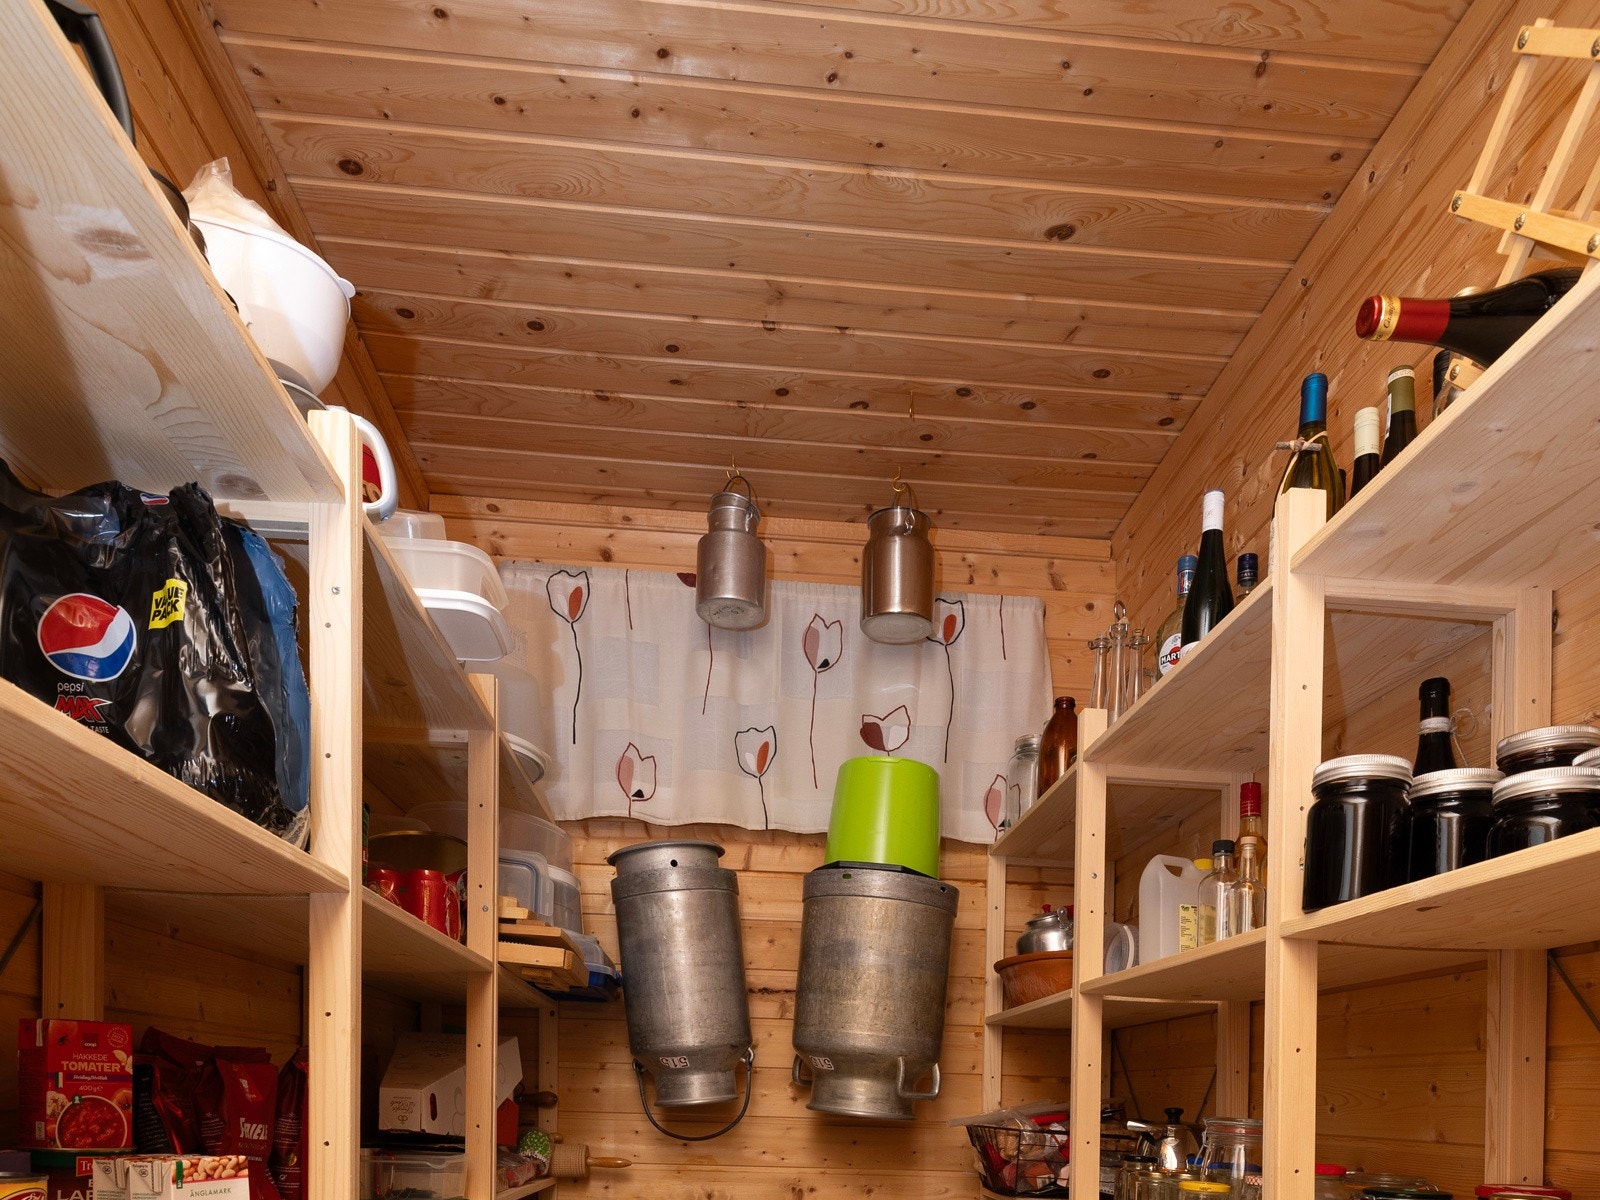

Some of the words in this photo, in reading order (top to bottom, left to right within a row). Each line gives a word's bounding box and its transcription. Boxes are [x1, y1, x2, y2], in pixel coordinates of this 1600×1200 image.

[1161, 652, 1180, 665] MART
[57, 682, 85, 693] pepsi
[55, 695, 113, 723] MAX
[73, 1052, 108, 1061] HAKKEDE
[61, 1061, 121, 1072] TOMATER
